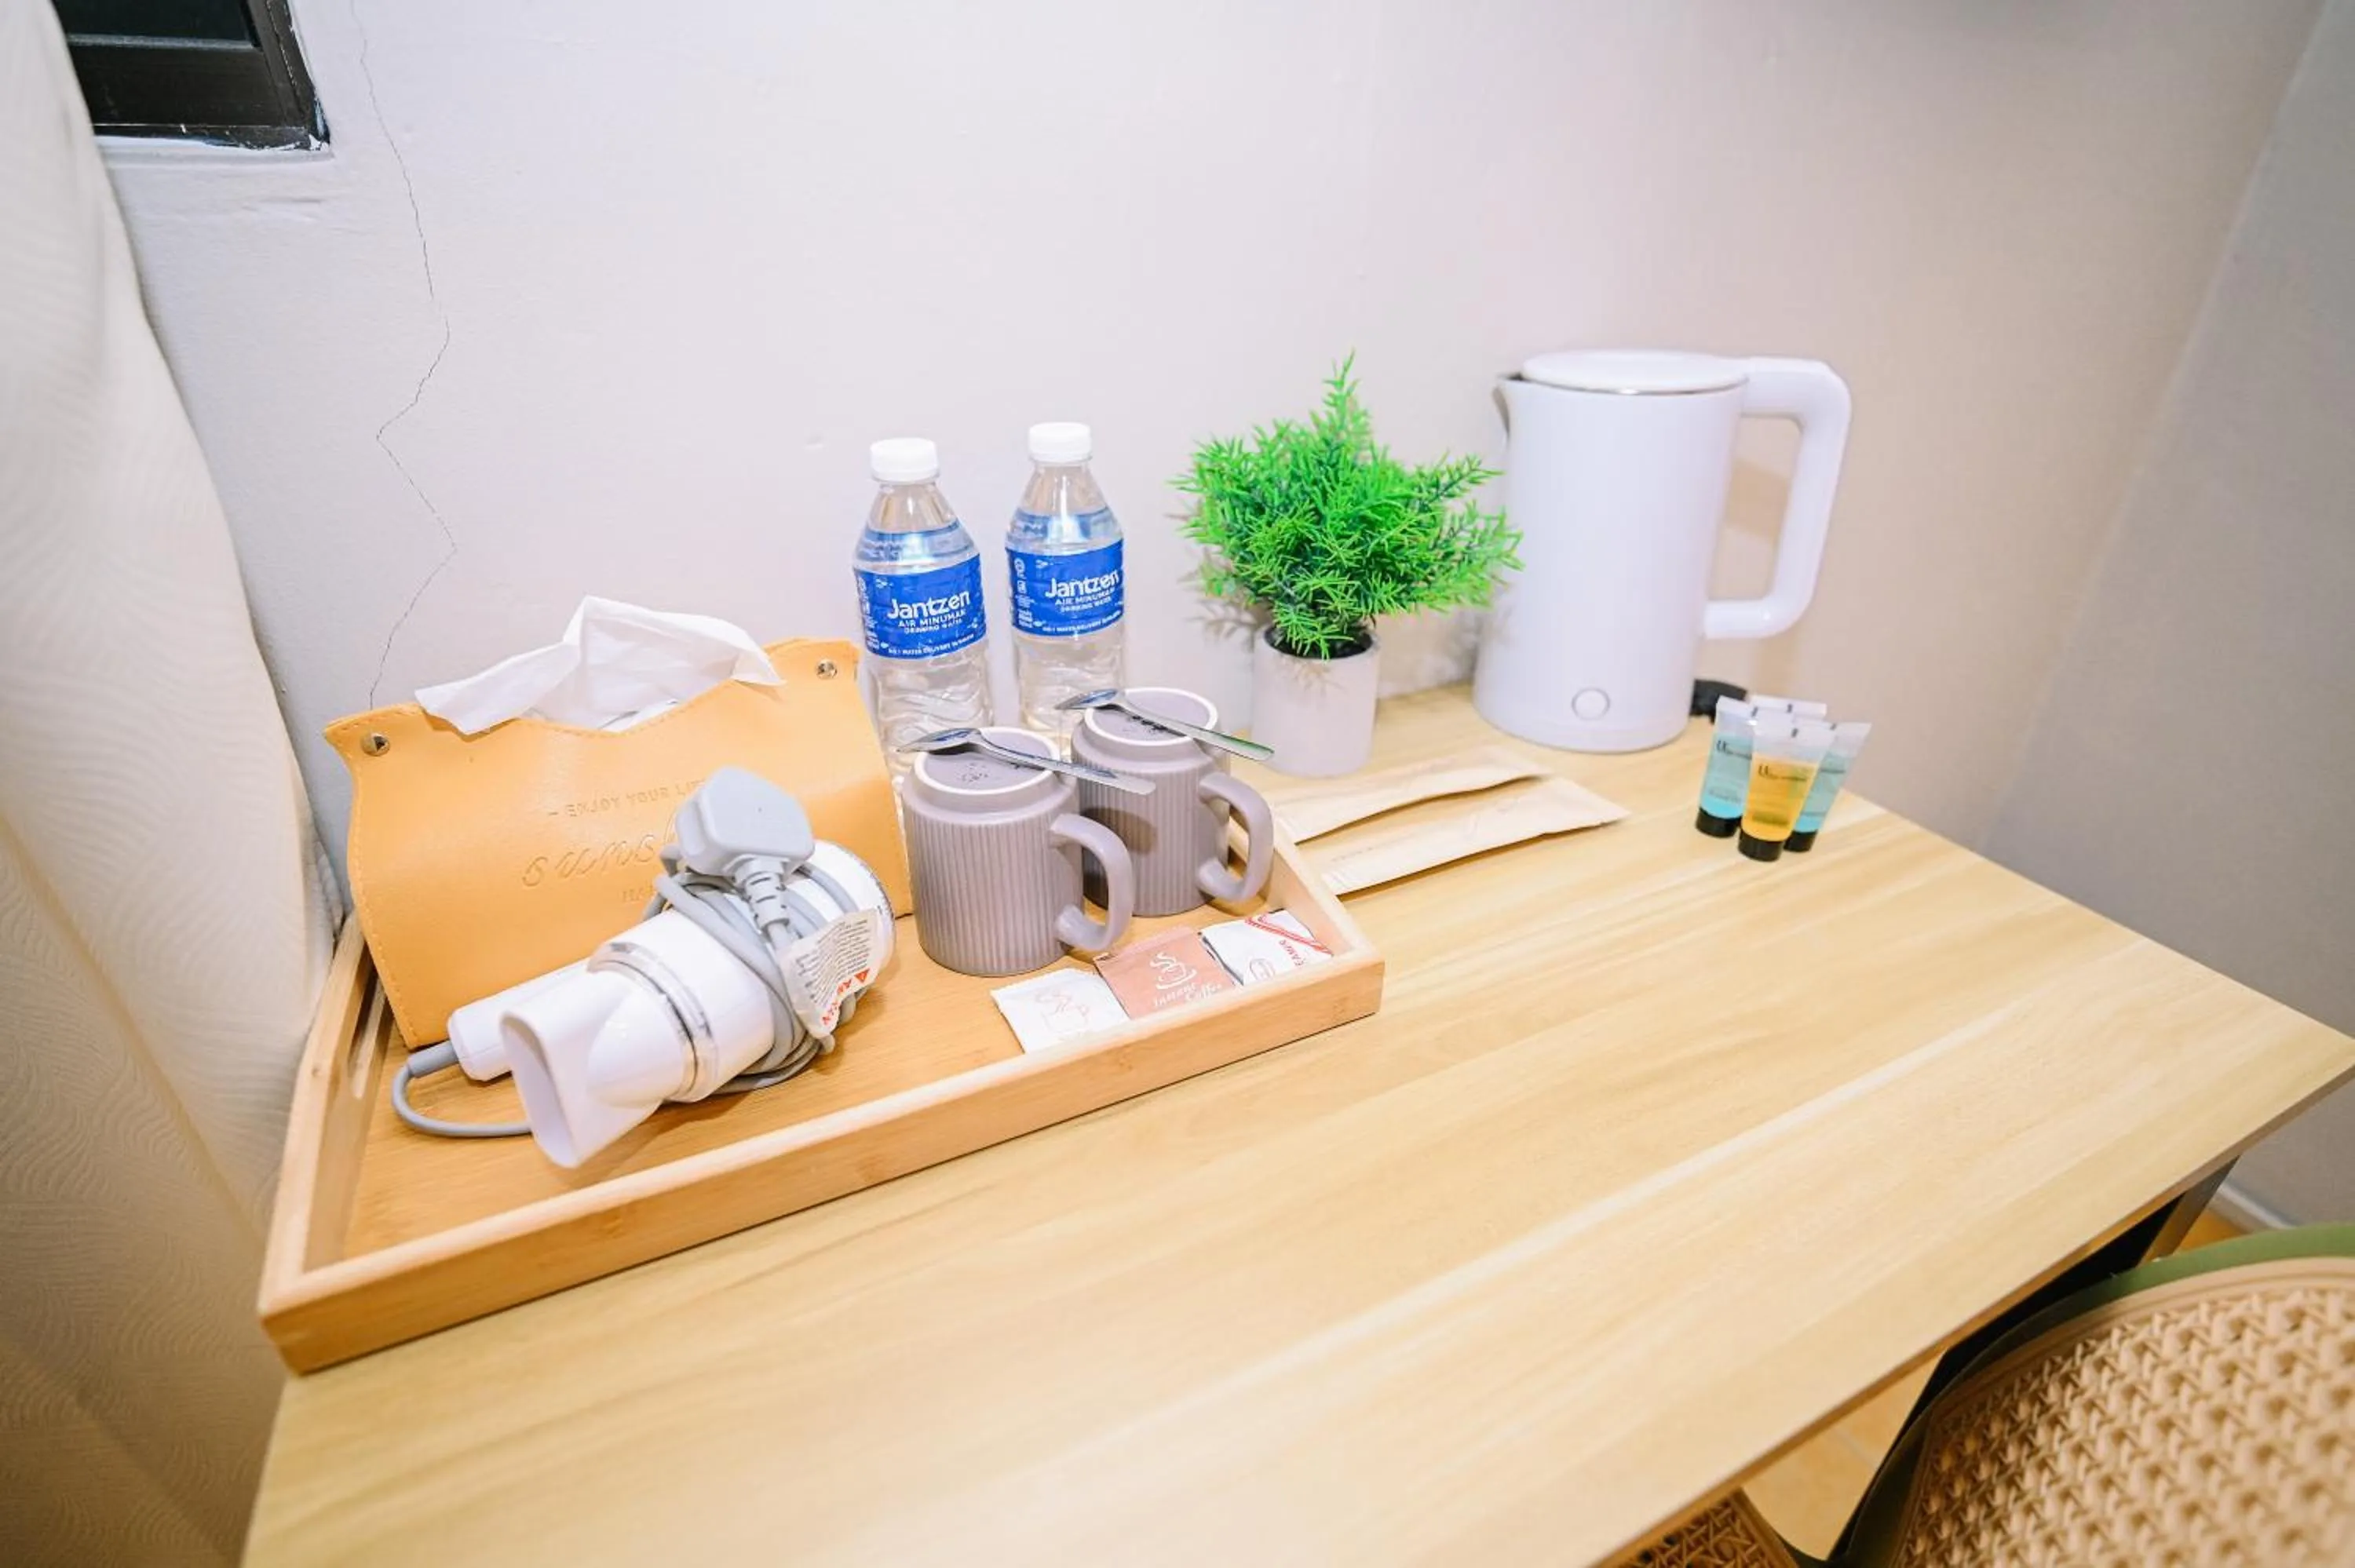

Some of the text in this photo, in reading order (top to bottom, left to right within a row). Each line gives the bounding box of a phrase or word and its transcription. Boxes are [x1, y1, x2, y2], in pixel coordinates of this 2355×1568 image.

[1045, 570, 1119, 598] Jantzen
[887, 591, 970, 619] Jantzen
[898, 619, 916, 628] AIR
[566, 795, 619, 818] ENJOY
[626, 786, 669, 807] YOUR
